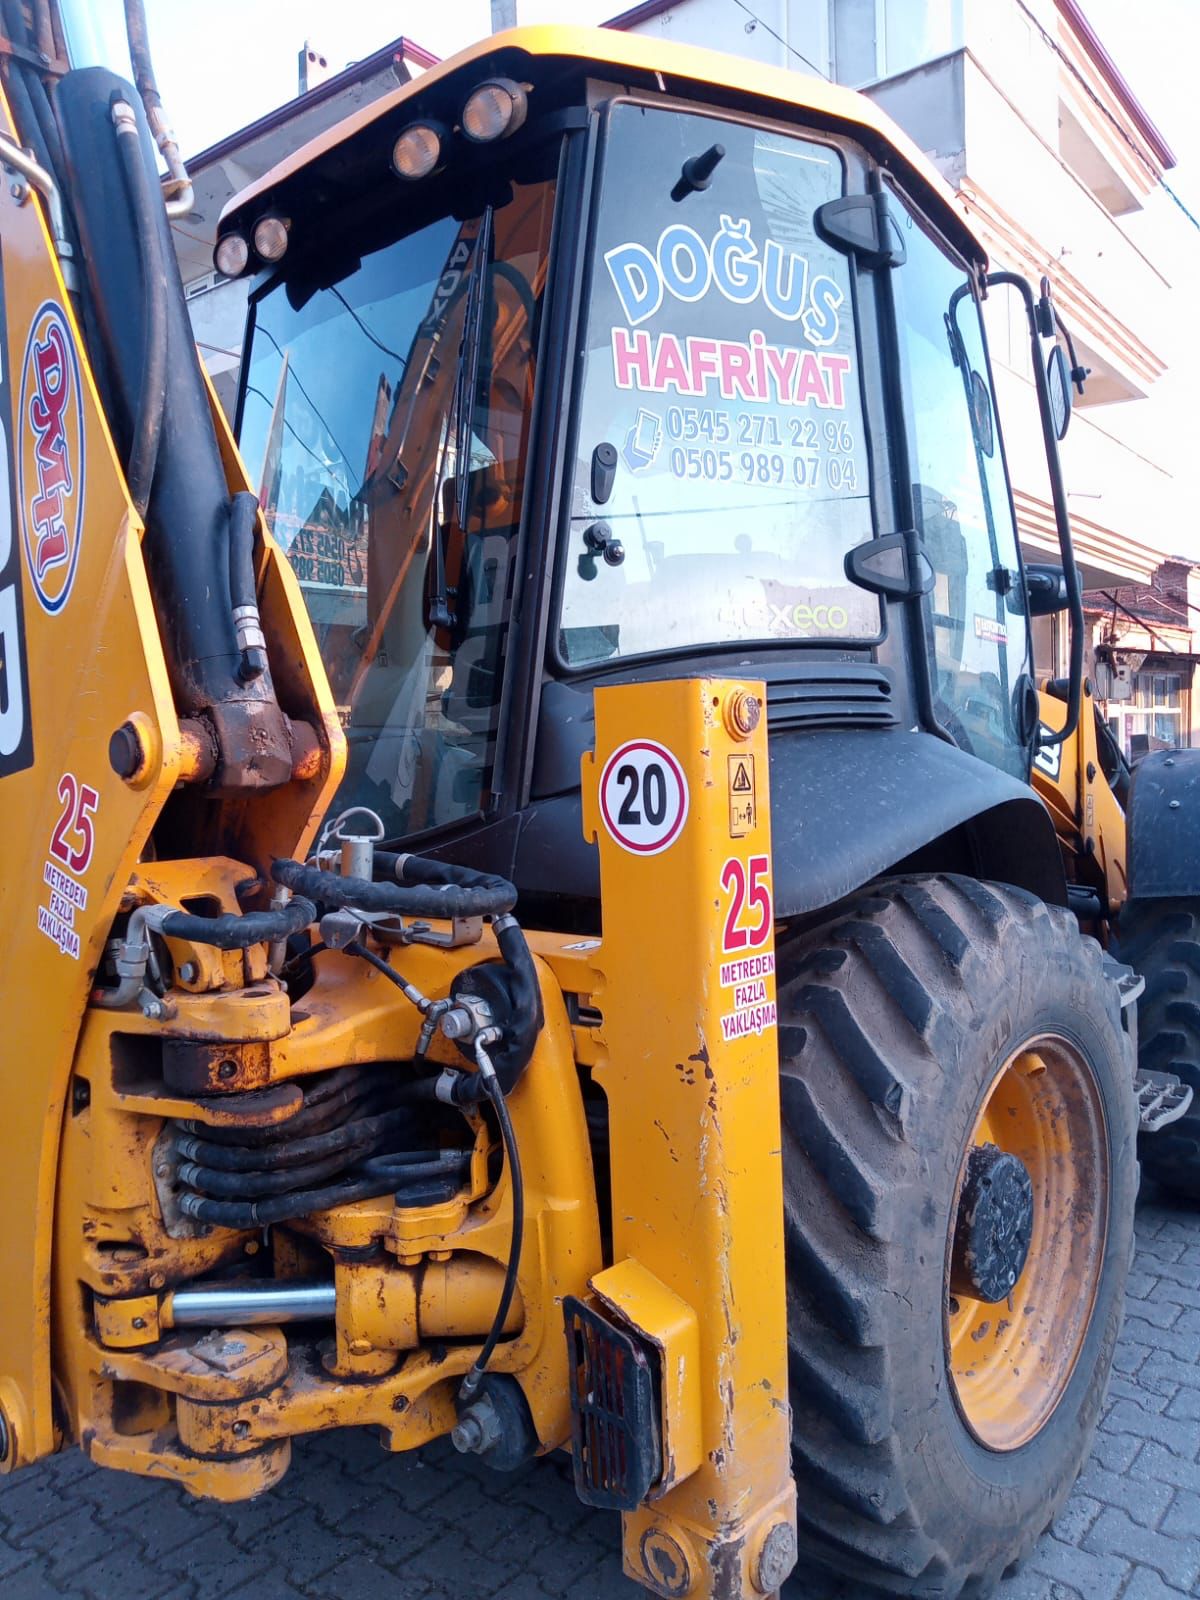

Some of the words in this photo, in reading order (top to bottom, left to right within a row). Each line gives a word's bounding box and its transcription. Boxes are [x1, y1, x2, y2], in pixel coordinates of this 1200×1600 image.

[604, 214, 844, 346] DOĞUŞ
[611, 327, 850, 410] HAFRİYAT
[31, 323, 73, 584] DMH
[666, 406, 730, 443] 0545
[737, 412, 781, 447] 271
[788, 418, 819, 451] 22
[823, 421, 854, 454] 96
[670, 447, 734, 481] 0505
[740, 452, 785, 485] 989
[792, 457, 820, 488] 07
[826, 458, 857, 491] 04
[617, 764, 668, 826] 20
[51, 774, 98, 874] 25
[45, 863, 87, 910] METREDEN
[50, 893, 75, 928] FAZLA
[721, 855, 773, 950] 25
[37, 906, 80, 960] YAKLAŞMA
[720, 952, 774, 986] METREDEN
[735, 983, 767, 1008] FAZLA
[721, 1001, 777, 1042] YAKLAŞMA
